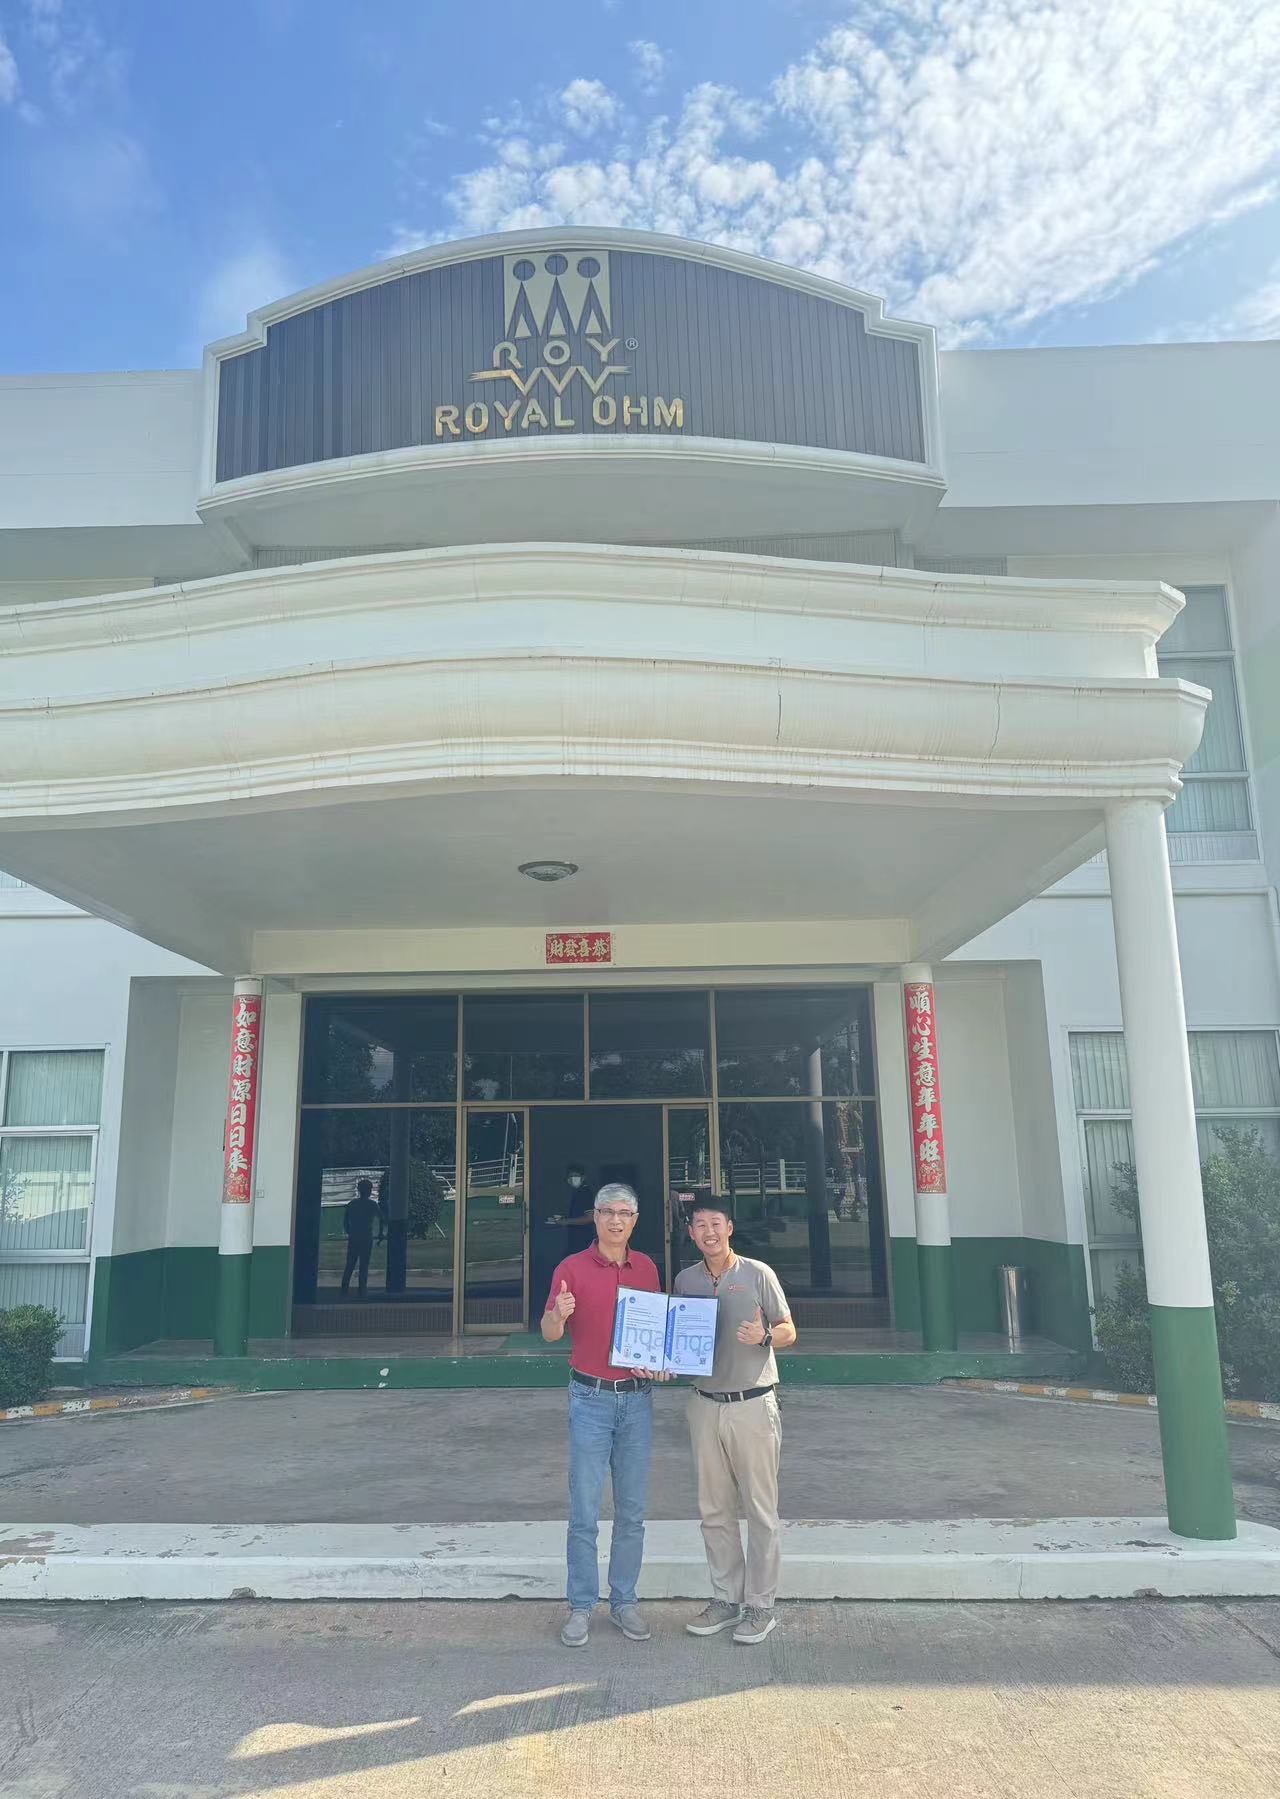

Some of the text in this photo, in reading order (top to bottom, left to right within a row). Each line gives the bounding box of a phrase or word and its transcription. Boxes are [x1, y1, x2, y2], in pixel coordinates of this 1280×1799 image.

[492, 337, 621, 369] ROY
[435, 395, 684, 437] ROYAL OHM
